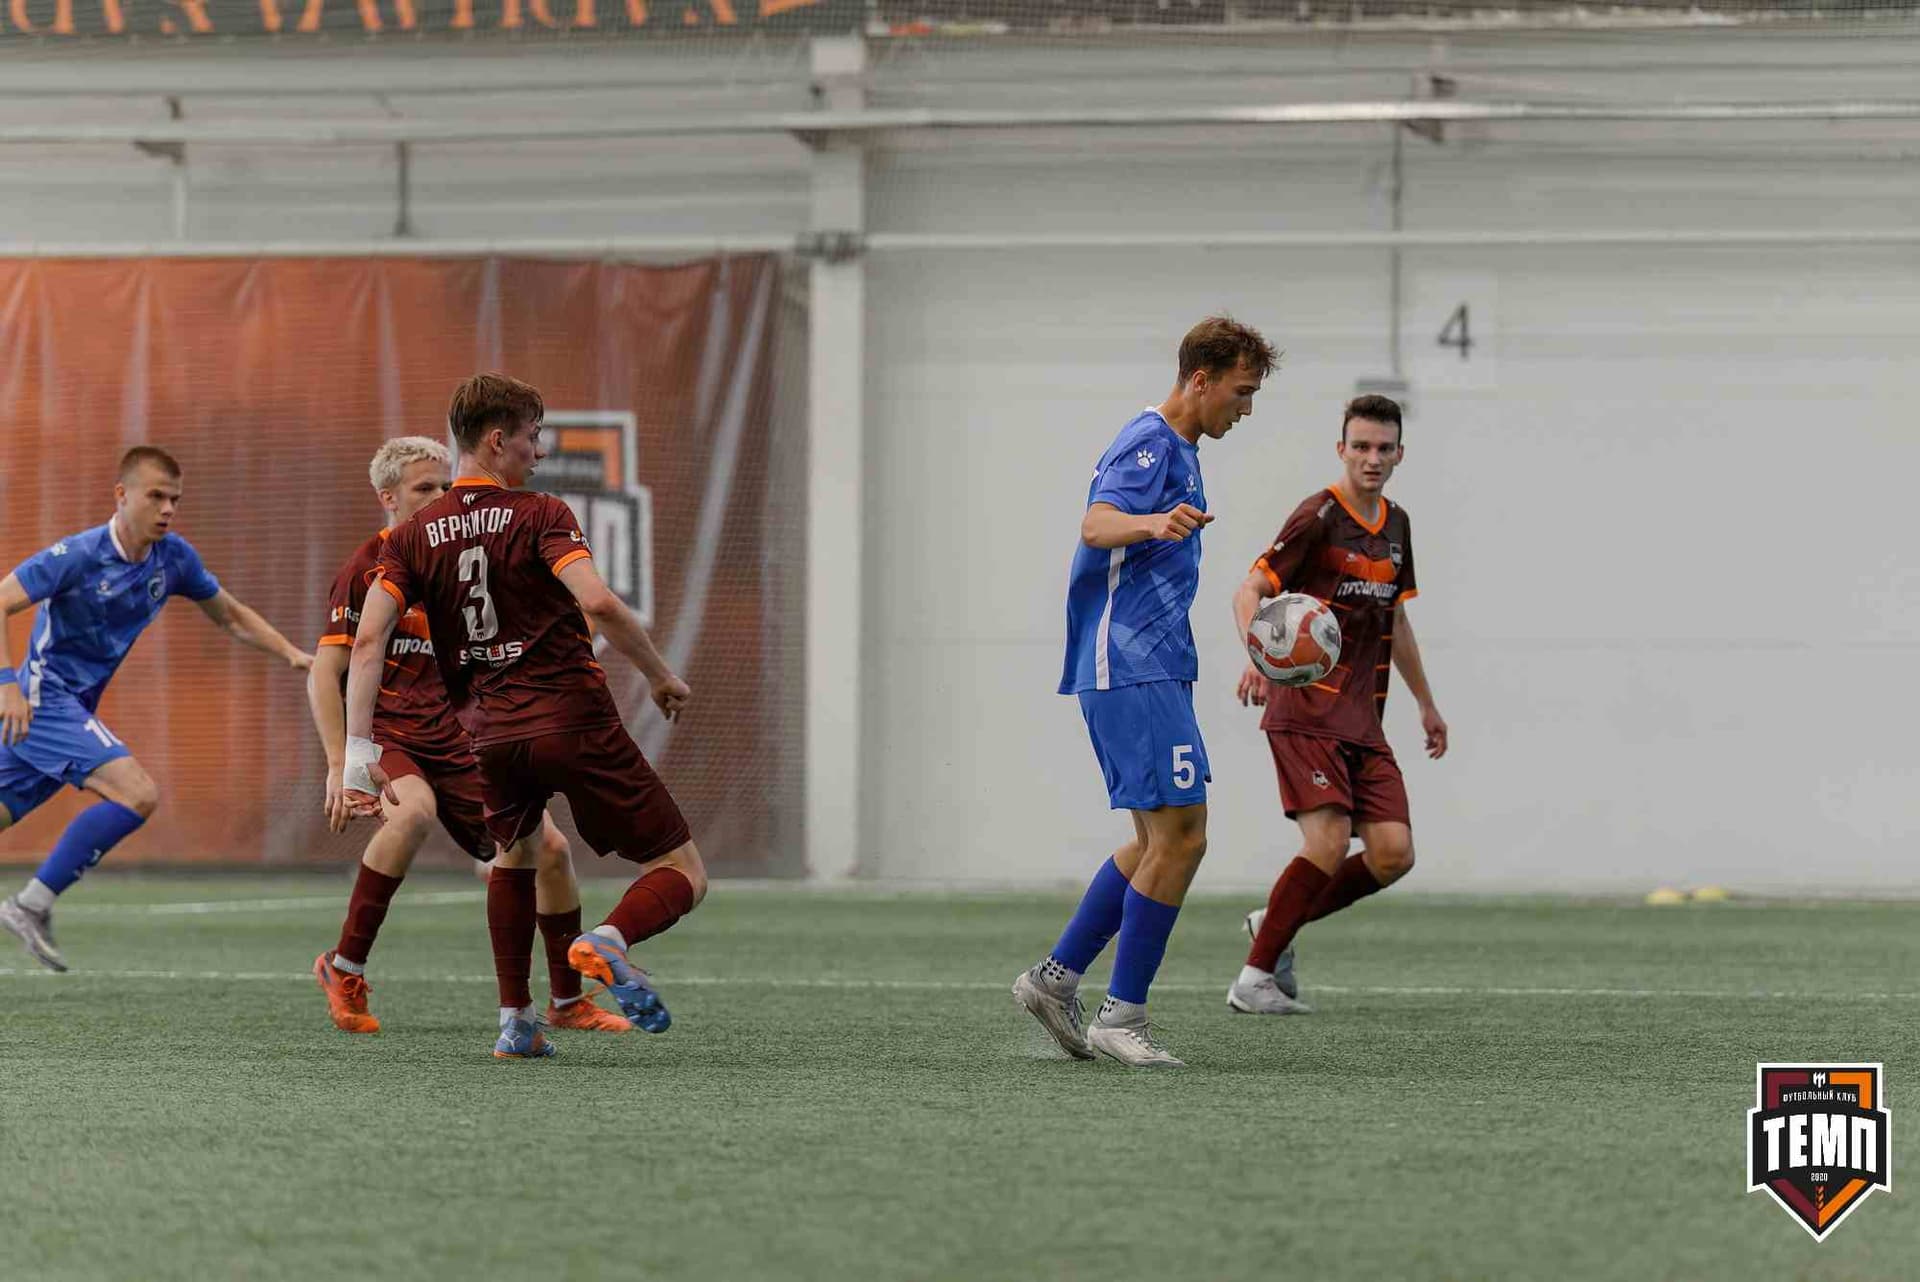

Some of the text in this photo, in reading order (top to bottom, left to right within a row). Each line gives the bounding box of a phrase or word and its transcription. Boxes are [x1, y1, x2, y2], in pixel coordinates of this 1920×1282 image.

[1438, 303, 1476, 358] 4
[458, 546, 499, 641] 3
[1173, 745, 1196, 789] 5
